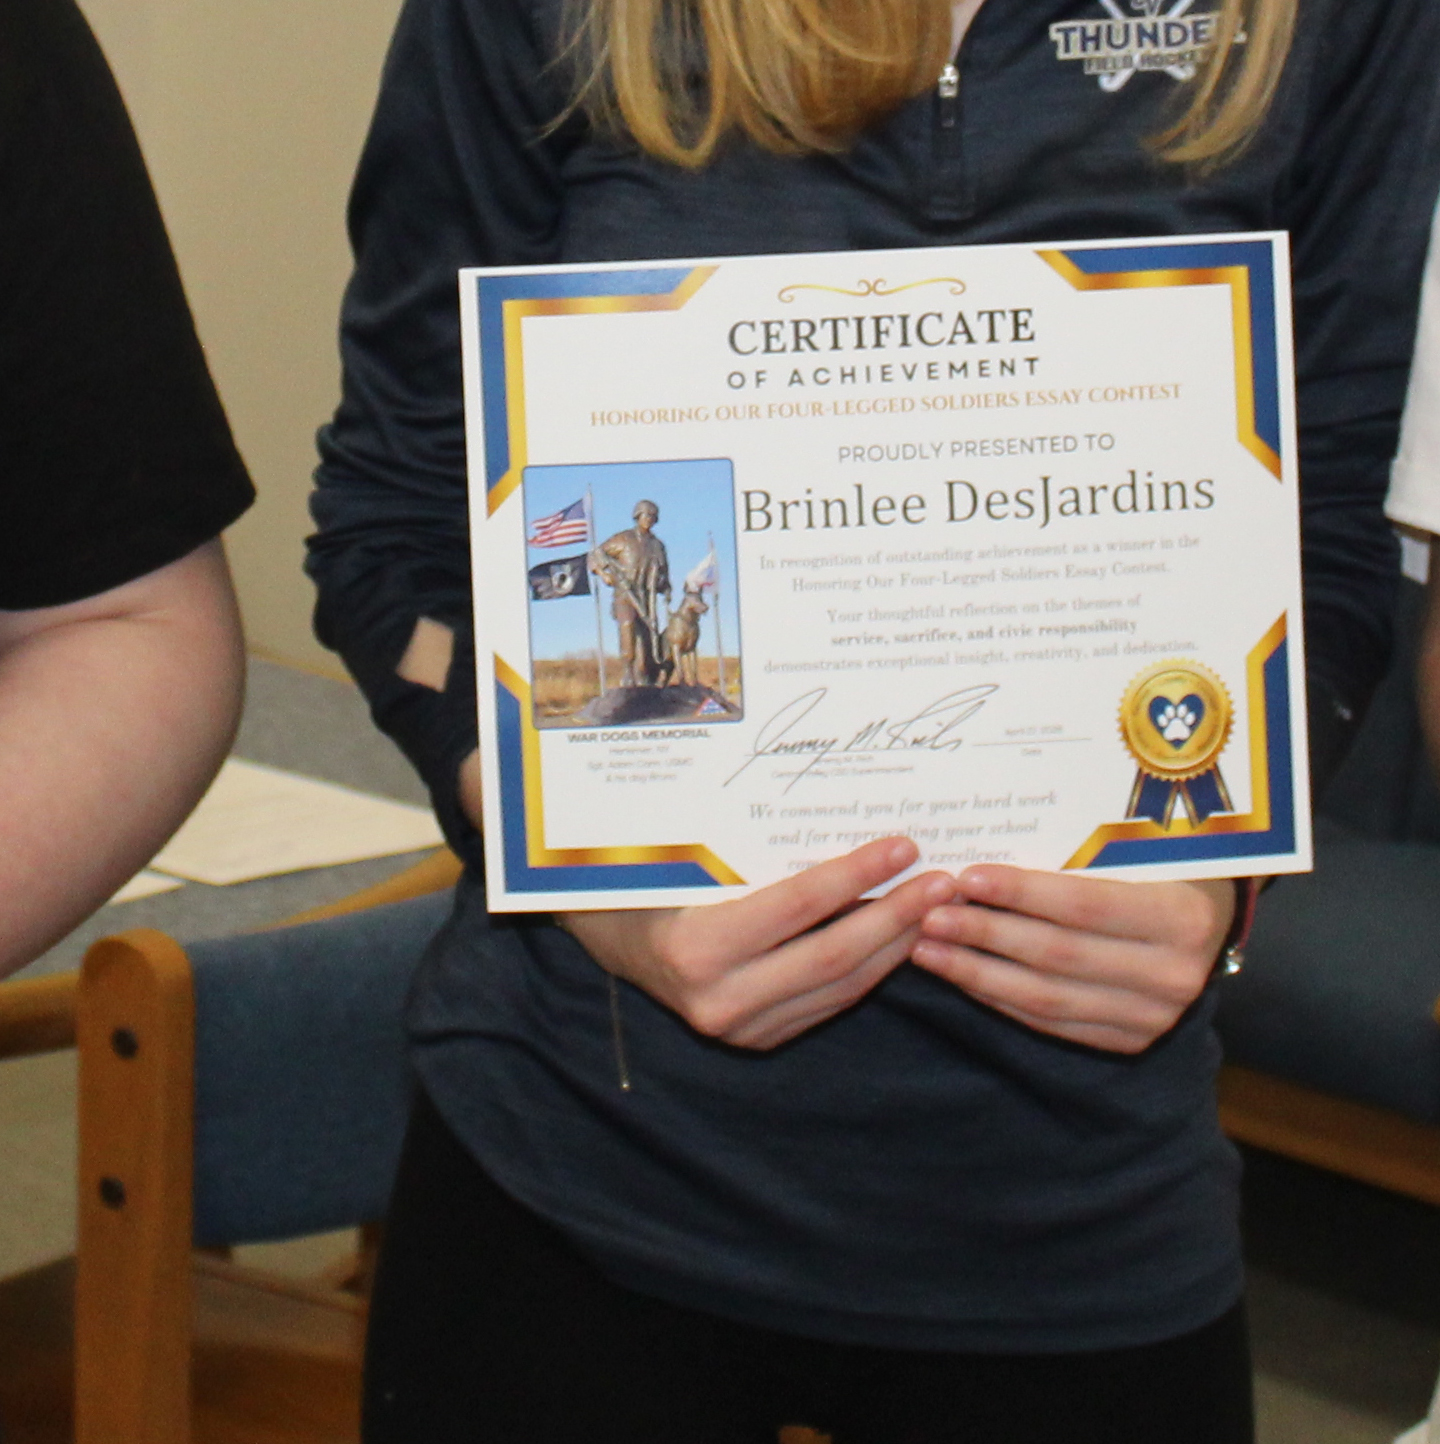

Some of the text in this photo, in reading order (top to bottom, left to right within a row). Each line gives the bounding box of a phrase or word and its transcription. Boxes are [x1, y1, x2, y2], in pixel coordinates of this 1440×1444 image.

[1056, 18, 1214, 54] THUNDE
[726, 308, 1035, 356] CERTIFICATE
[725, 356, 1040, 389] OF ACHIEVEMENT
[590, 382, 1181, 426] HONORING OUR FOUR-LEGGED SOLDIERS ESSAY CONTEST
[837, 431, 1115, 464] PROUDLY PRESENTED TO
[742, 468, 1214, 532] Brinlee DesJardins
[791, 573, 862, 595] Honoring
[865, 572, 894, 588] Our
[898, 567, 996, 590] Four-Legged
[999, 563, 1059, 581] Soldiers
[1062, 561, 1106, 581] Essay
[964, 625, 993, 640] and
[996, 623, 1032, 638] civic
[1035, 617, 1136, 640] responsibility
[567, 727, 712, 743] WAR DOGS MEMORIAL
